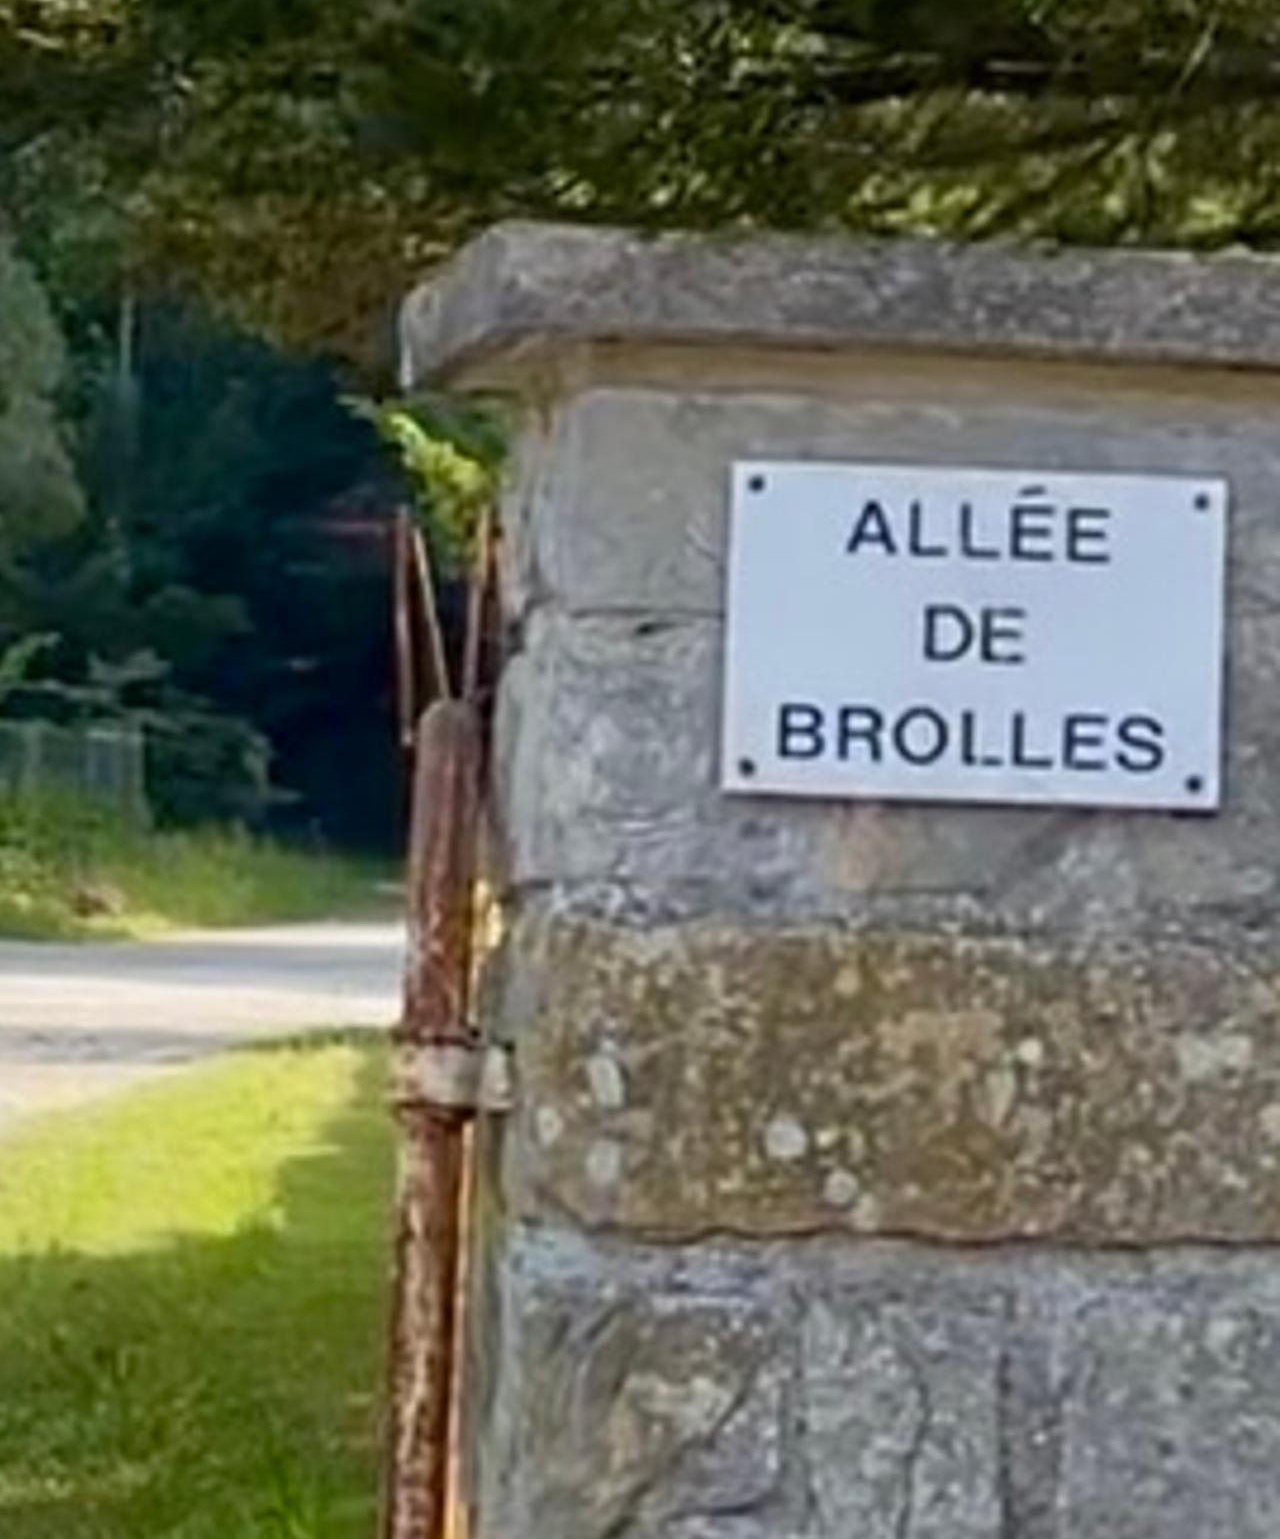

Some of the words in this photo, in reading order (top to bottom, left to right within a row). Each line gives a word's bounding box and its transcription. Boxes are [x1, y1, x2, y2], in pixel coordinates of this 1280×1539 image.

[845, 485, 1111, 564] ALLÉE
[922, 604, 1027, 665] DE
[776, 702, 1166, 774] BROLLES
